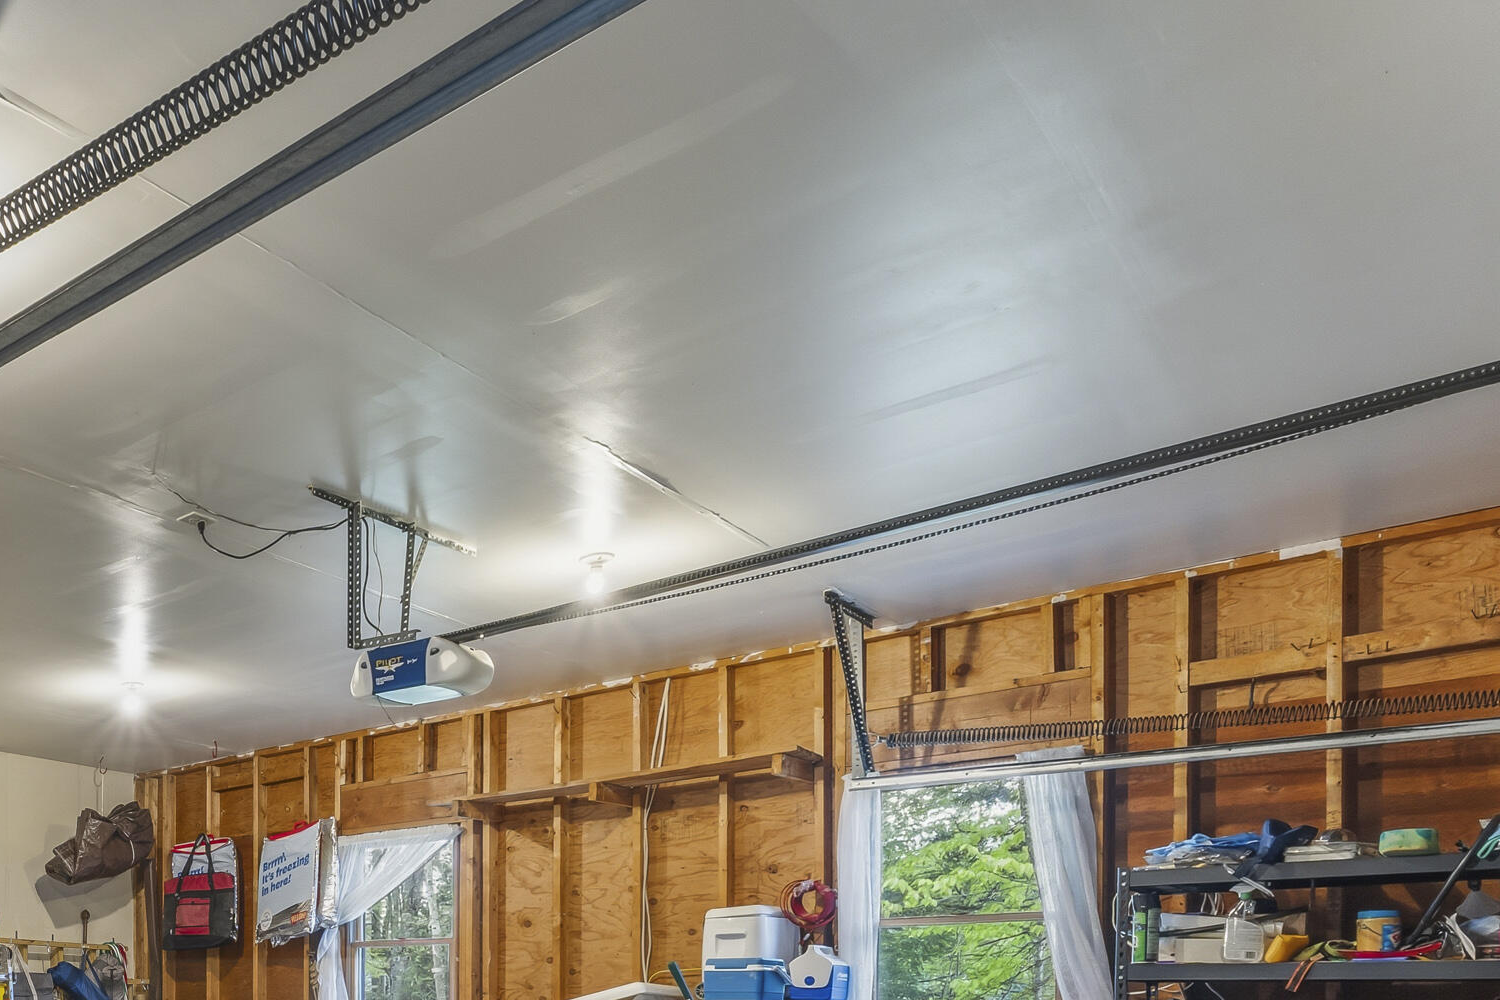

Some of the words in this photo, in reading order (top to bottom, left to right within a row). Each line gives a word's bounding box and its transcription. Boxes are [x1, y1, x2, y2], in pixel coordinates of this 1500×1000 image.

[375, 656, 404, 668] PILOT
[262, 872, 275, 885] It's
[276, 853, 310, 878] freezing
[261, 886, 269, 897] in
[270, 873, 292, 893] here!
